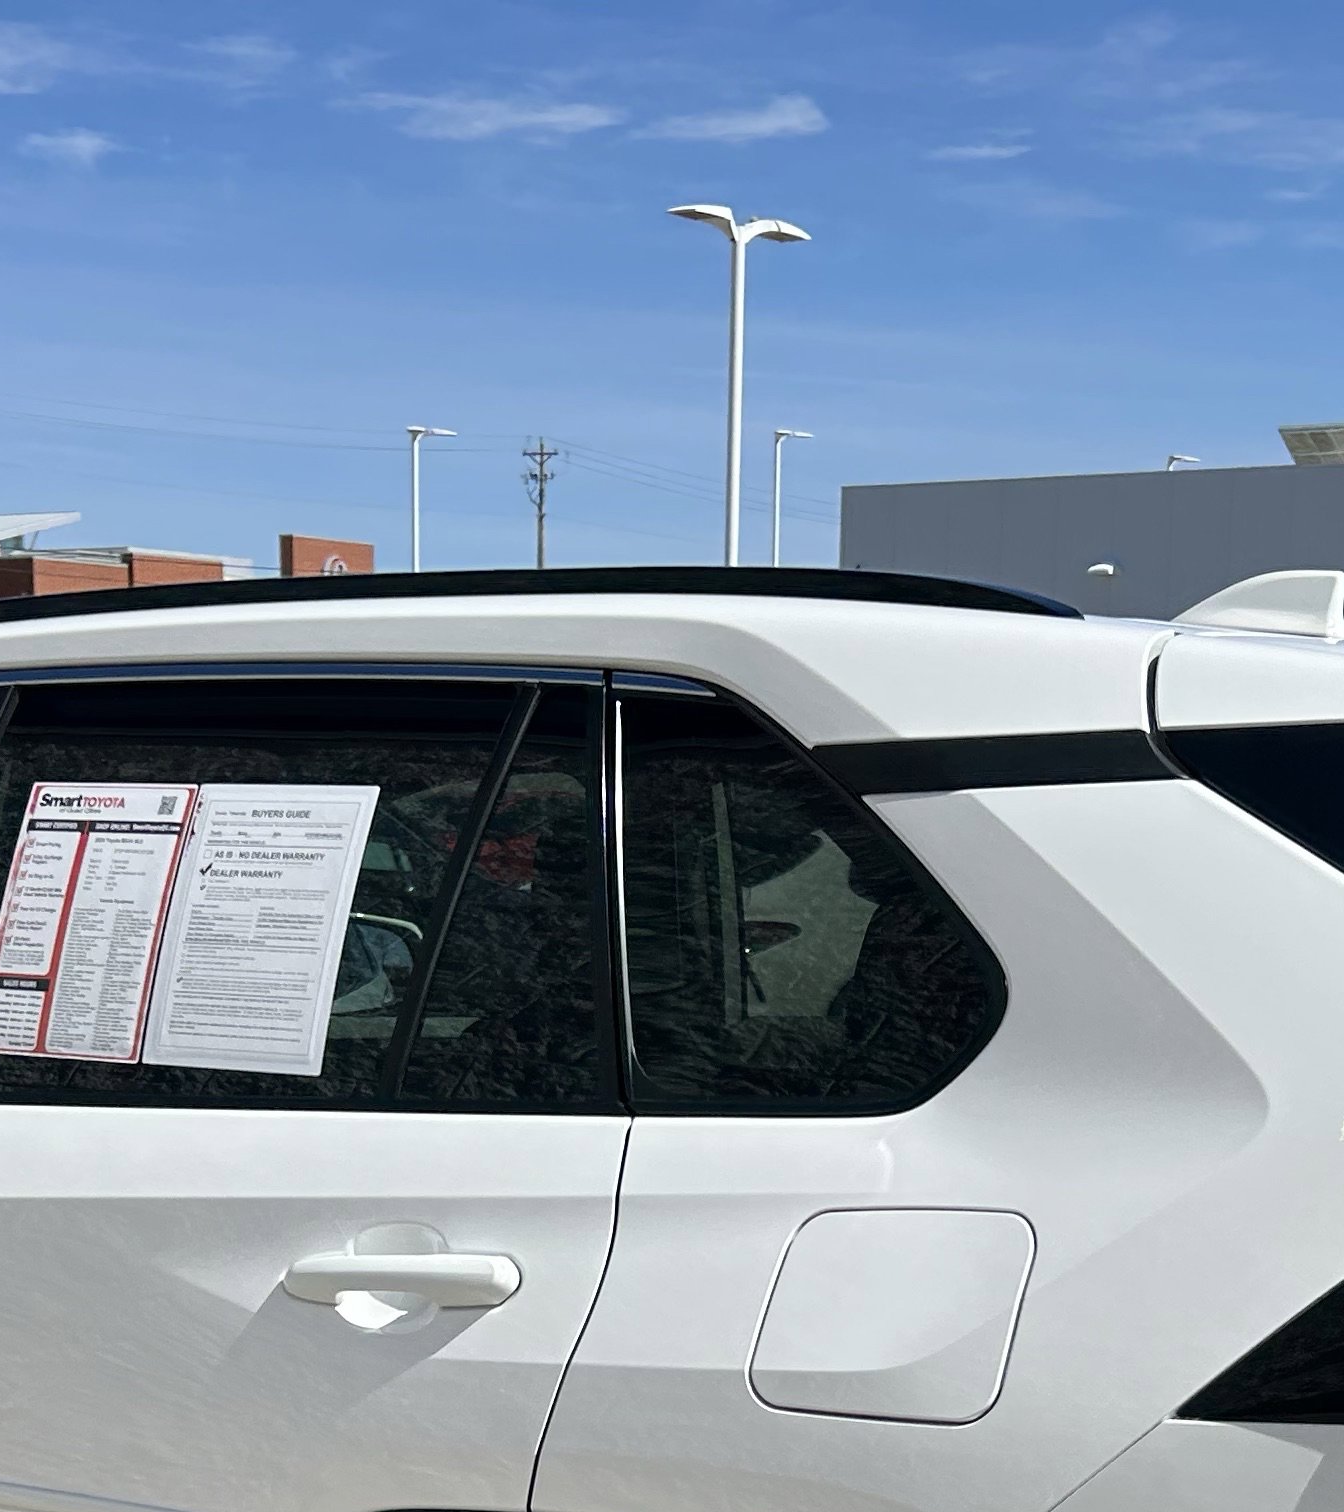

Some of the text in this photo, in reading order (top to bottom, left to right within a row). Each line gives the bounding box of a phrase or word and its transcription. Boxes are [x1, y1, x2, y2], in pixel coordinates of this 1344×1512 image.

[251, 809, 284, 818] BUYERS
[285, 810, 312, 819] GUIDE
[282, 852, 326, 861] WARRANTY
[210, 869, 284, 879] DEALER WARRANTY
